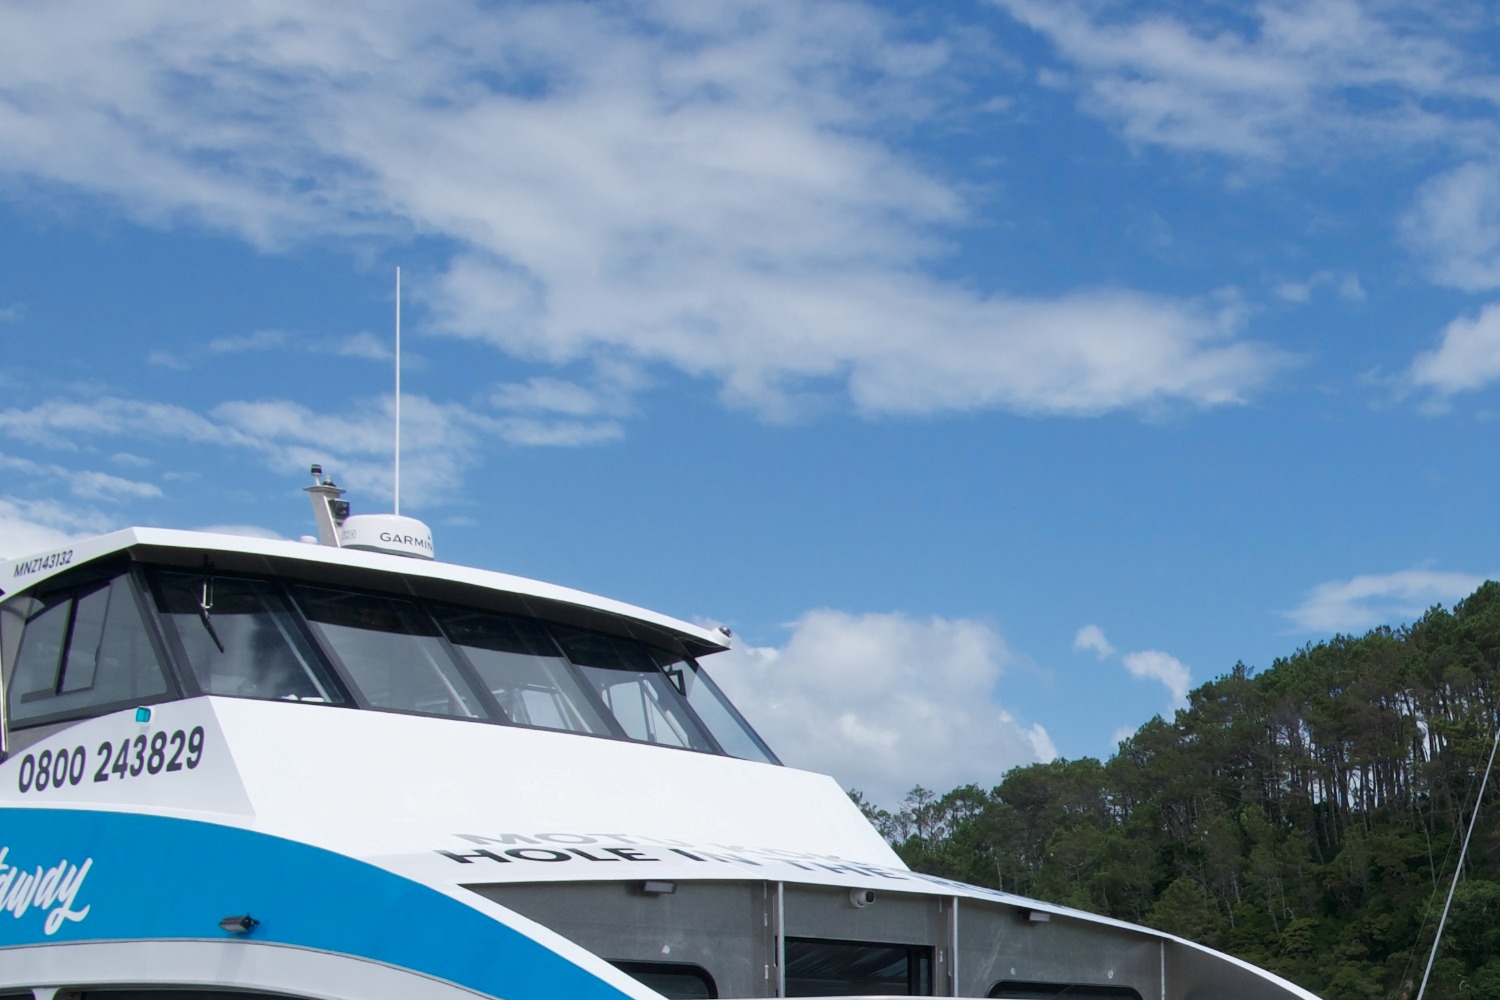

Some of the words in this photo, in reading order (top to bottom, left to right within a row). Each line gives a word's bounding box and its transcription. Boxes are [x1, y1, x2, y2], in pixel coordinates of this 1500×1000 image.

[379, 532, 433, 551] GARMIN
[13, 549, 73, 578] MNZ143132
[18, 745, 86, 793] 0800
[93, 726, 205, 783] 243829
[433, 848, 661, 863] HOLE
[667, 849, 763, 867] IN
[762, 857, 910, 881] THE
